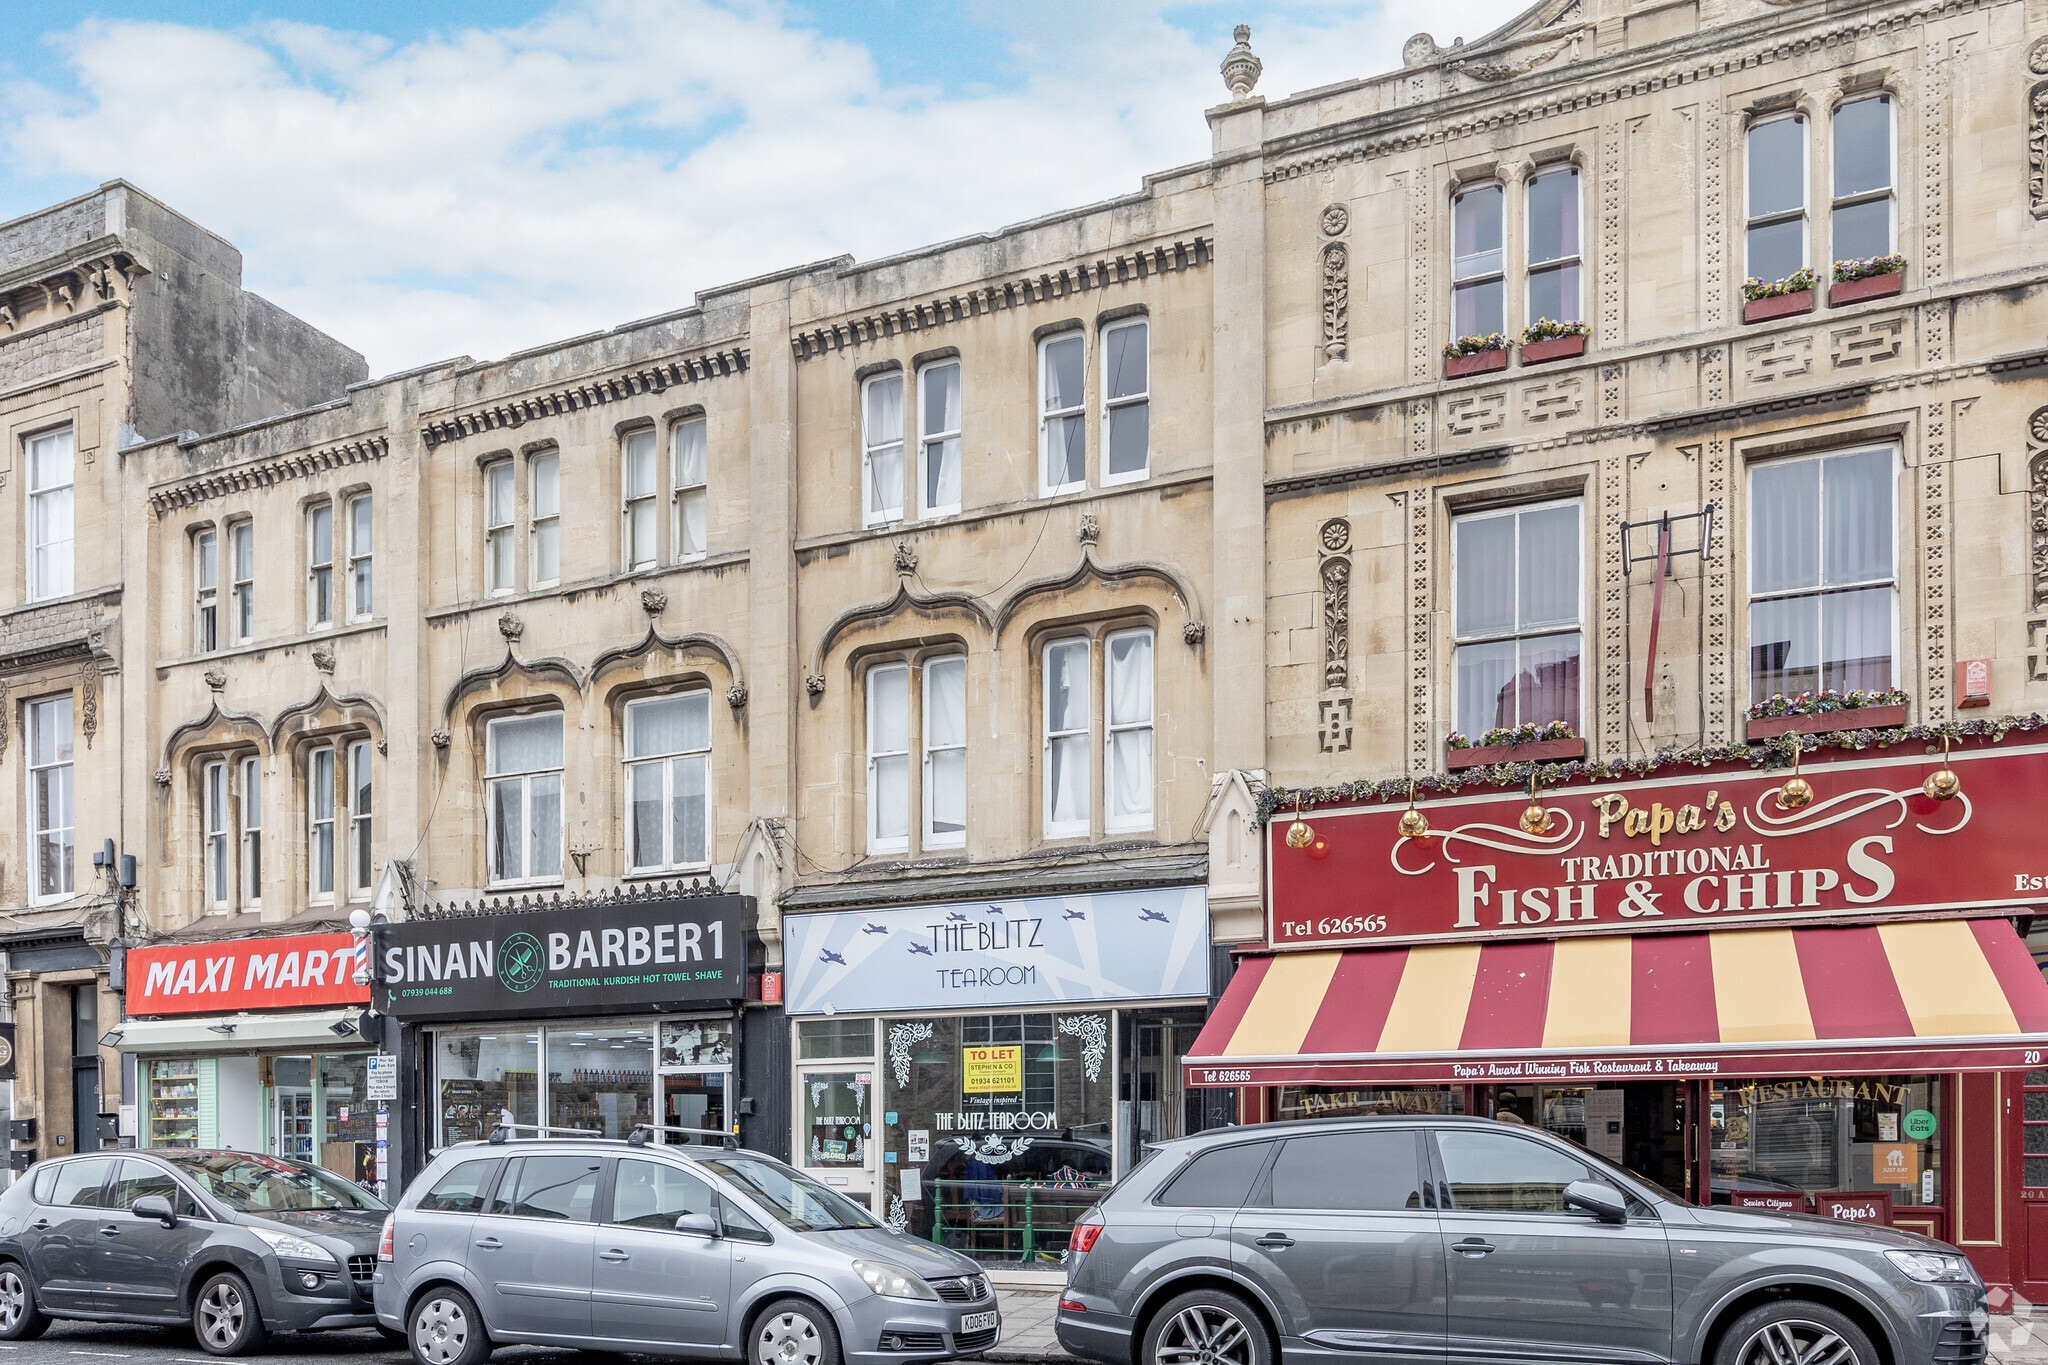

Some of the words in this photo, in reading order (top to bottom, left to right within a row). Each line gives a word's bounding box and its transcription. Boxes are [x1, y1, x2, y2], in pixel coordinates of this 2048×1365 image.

[1592, 790, 1736, 846] Papa's
[1561, 844, 1770, 884] TRADITIONAL
[1452, 864, 1599, 928] FISH
[1618, 880, 1664, 918] &
[1683, 835, 1896, 914] CHIPS
[1282, 920, 1312, 936] Tel
[1318, 914, 1387, 934] 626565
[926, 923, 977, 952] THE
[979, 918, 1044, 950] BLITZ
[144, 956, 236, 996] MAXI
[244, 947, 356, 991] MART
[386, 940, 494, 984] SINAN
[548, 977, 600, 988] TRADITIONAL
[604, 976, 640, 986] KURDISH
[642, 974, 660, 983] HOT
[662, 972, 691, 982] TOWEL
[695, 970, 722, 980] SHAVE
[402, 988, 424, 998] 07939
[424, 987, 438, 996] 044
[439, 986, 452, 996] 688
[970, 1050, 987, 1060] TO
[992, 1049, 1014, 1060] LET
[2024, 1050, 2040, 1064] 20
[1203, 1070, 1216, 1082] Tel
[1219, 1070, 1250, 1082] 626565
[1453, 1064, 1484, 1078] Papa's
[1488, 1064, 1522, 1076] Award
[1525, 1062, 1566, 1076] Winning
[1569, 1061, 1591, 1074] Fish
[1593, 1060, 1652, 1073] Restaurant
[1654, 1060, 1664, 1072] &
[1666, 1059, 1718, 1073] Takeaway
[970, 1096, 992, 1105] Vintage
[994, 1096, 1018, 1105] inspired
[1739, 1080, 1911, 1107] RESTAURANT
[1300, 1092, 1360, 1116] TAKE
[1375, 1091, 1440, 1114] AWAY
[935, 1112, 954, 1130] THE
[957, 1112, 984, 1130] BLITZ
[988, 1111, 1058, 1130] TEAROOM
[1743, 1199, 1765, 1207] Senior
[1766, 1199, 1792, 1210] Citizens
[1831, 1204, 1876, 1220] Papa's
